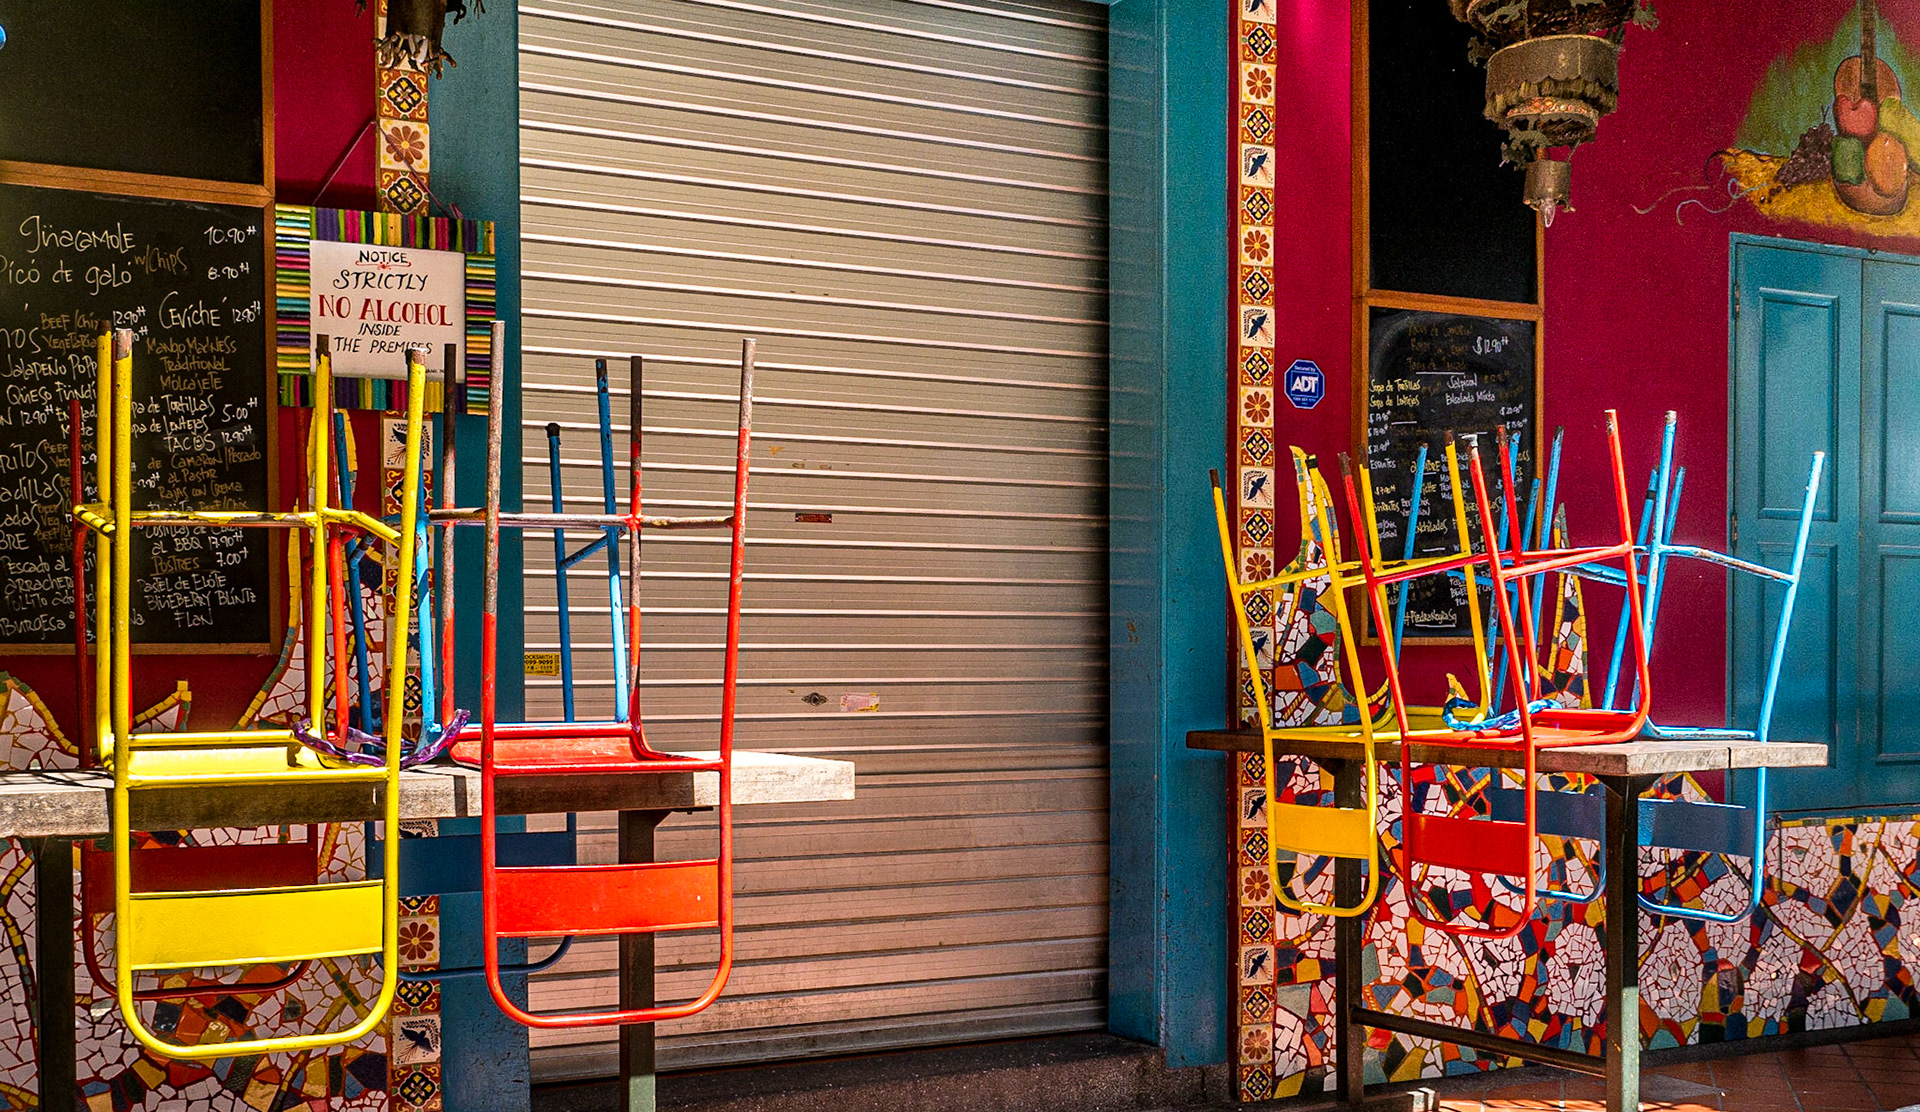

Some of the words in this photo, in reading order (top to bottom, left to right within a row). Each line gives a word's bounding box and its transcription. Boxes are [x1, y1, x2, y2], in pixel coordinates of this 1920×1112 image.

[359, 250, 408, 263] NOTICE
[333, 269, 428, 290] STRICTLY
[318, 294, 351, 319] NO
[358, 298, 453, 326] ALCOHOL
[357, 322, 402, 336] INSIDE
[333, 336, 362, 353] THE
[1291, 375, 1319, 393] ADT
